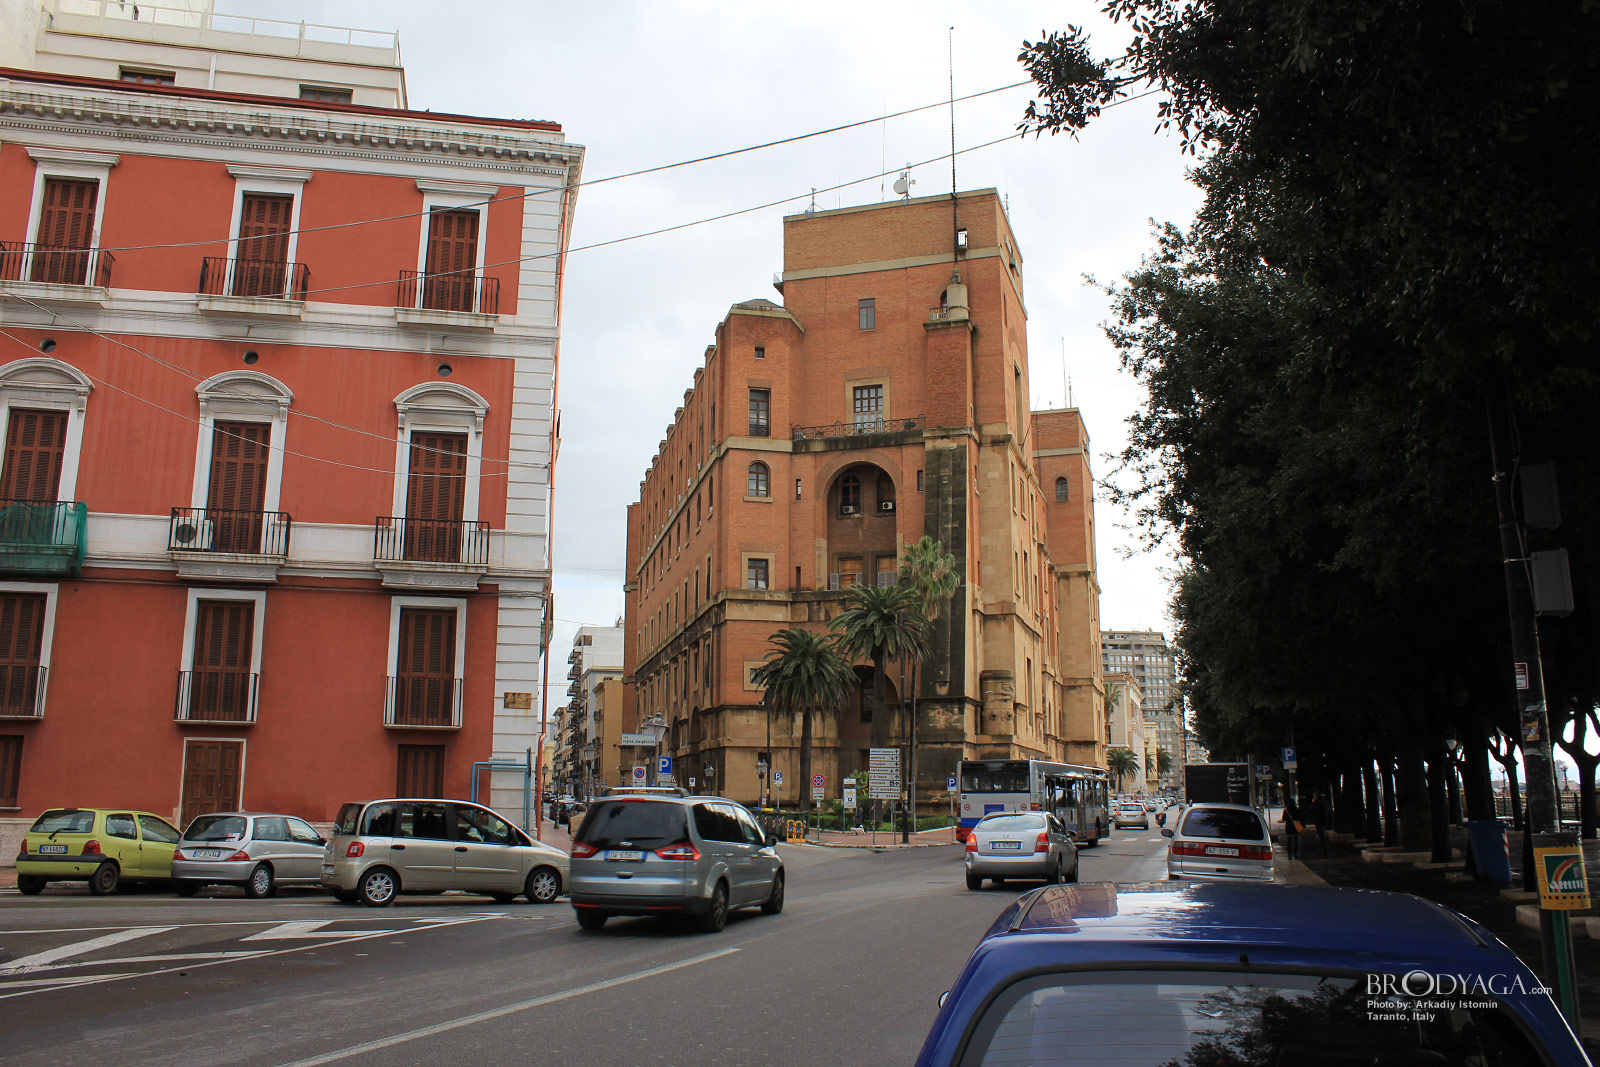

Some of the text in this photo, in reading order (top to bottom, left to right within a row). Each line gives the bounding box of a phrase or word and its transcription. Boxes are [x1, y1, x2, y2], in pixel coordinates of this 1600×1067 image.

[1284, 748, 1294, 760] P
[658, 758, 670, 772] P
[1263, 765, 1270, 775] P
[775, 772, 781, 780] P
[948, 778, 956, 787] P
